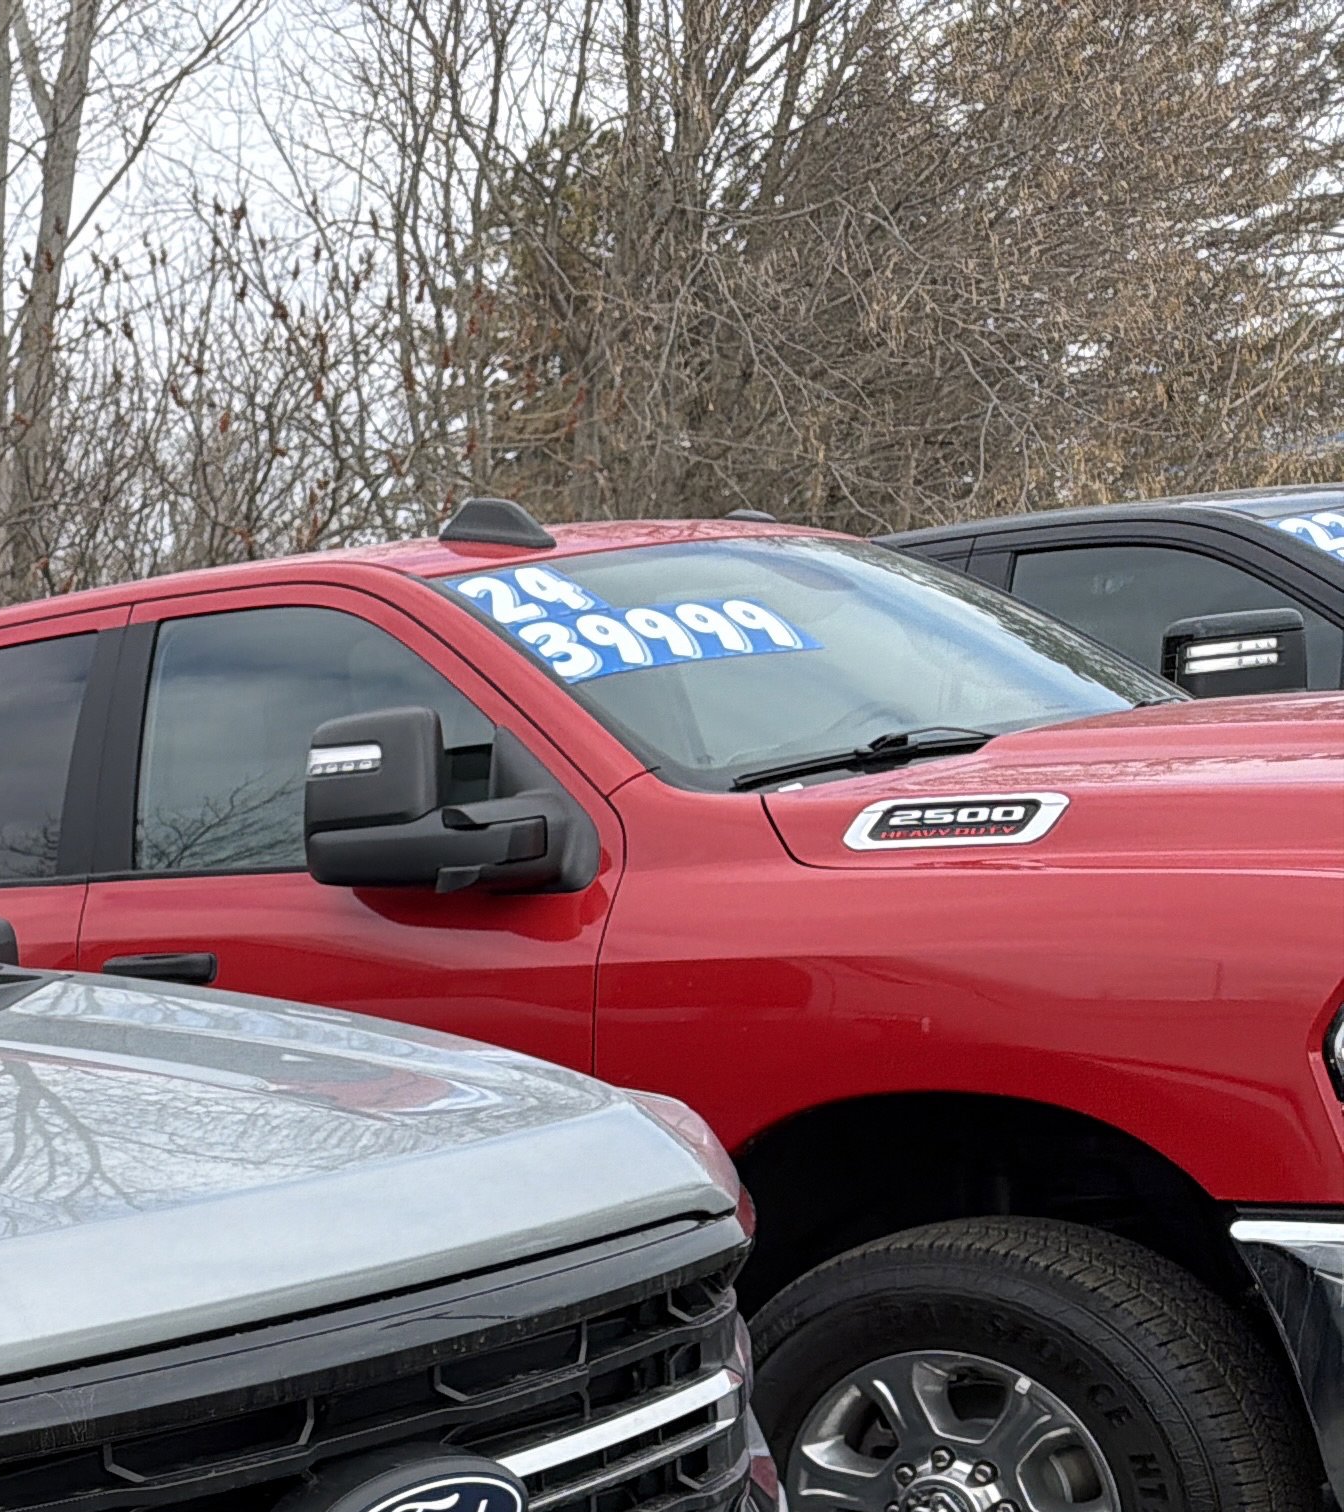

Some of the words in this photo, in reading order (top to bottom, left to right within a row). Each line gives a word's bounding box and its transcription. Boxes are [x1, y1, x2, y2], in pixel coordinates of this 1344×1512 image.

[457, 567, 595, 624] 24
[518, 600, 803, 678] 39999
[879, 827, 951, 839] HEAVY
[953, 825, 1017, 836] DUTY
[888, 805, 1026, 826] 2500
